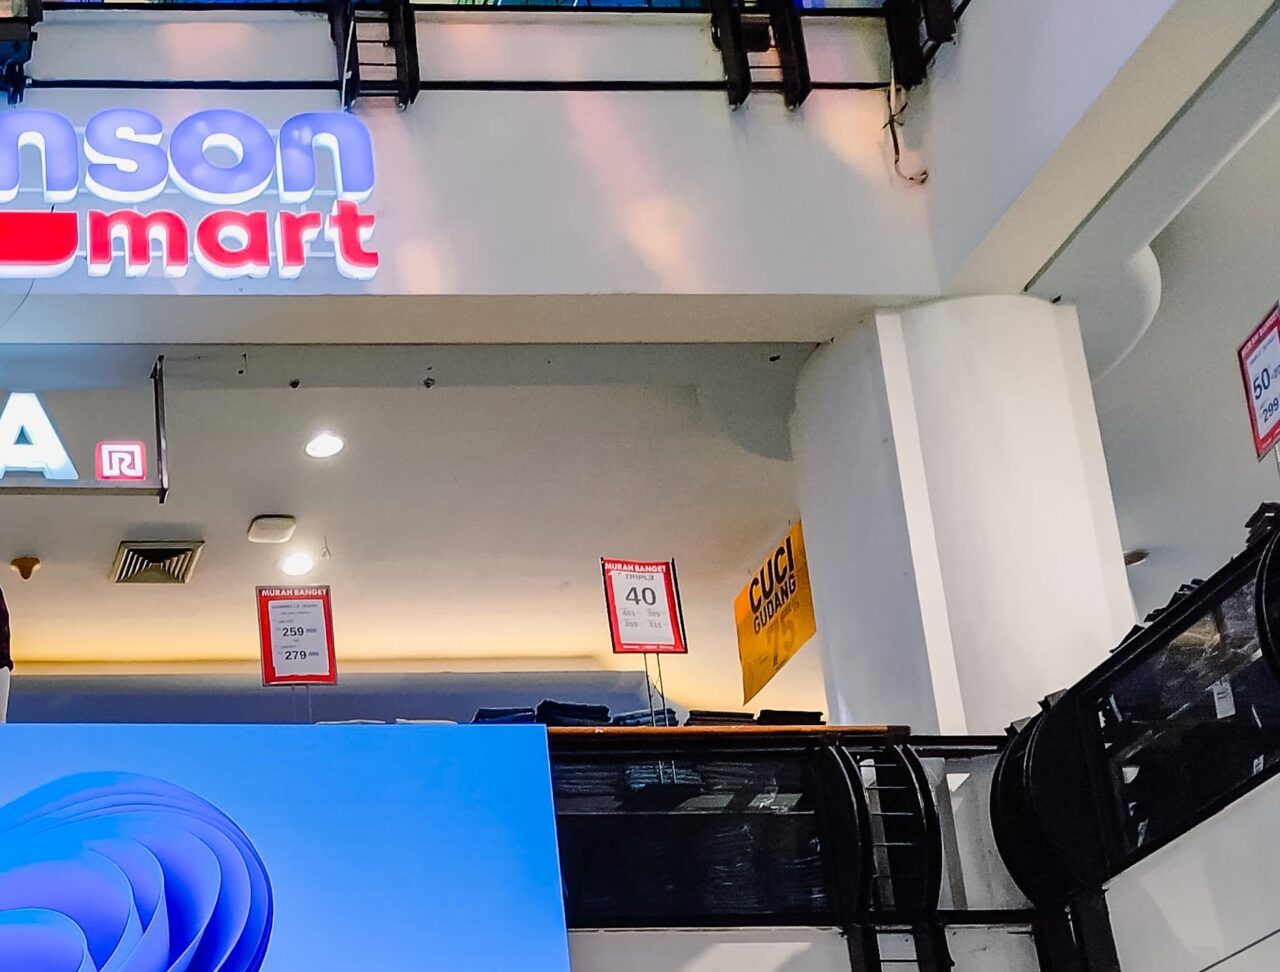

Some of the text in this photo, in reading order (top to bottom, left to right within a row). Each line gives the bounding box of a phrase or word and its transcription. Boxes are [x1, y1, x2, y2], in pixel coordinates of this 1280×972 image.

[87, 200, 381, 281] mart
[605, 562, 666, 573] MURAH BANGET
[748, 535, 795, 615] CUCI
[261, 588, 327, 597] MURAH BANGET
[625, 586, 657, 606] 40
[753, 573, 797, 635] GUDANG
[282, 626, 305, 637] 259
[284, 650, 307, 661] 279
